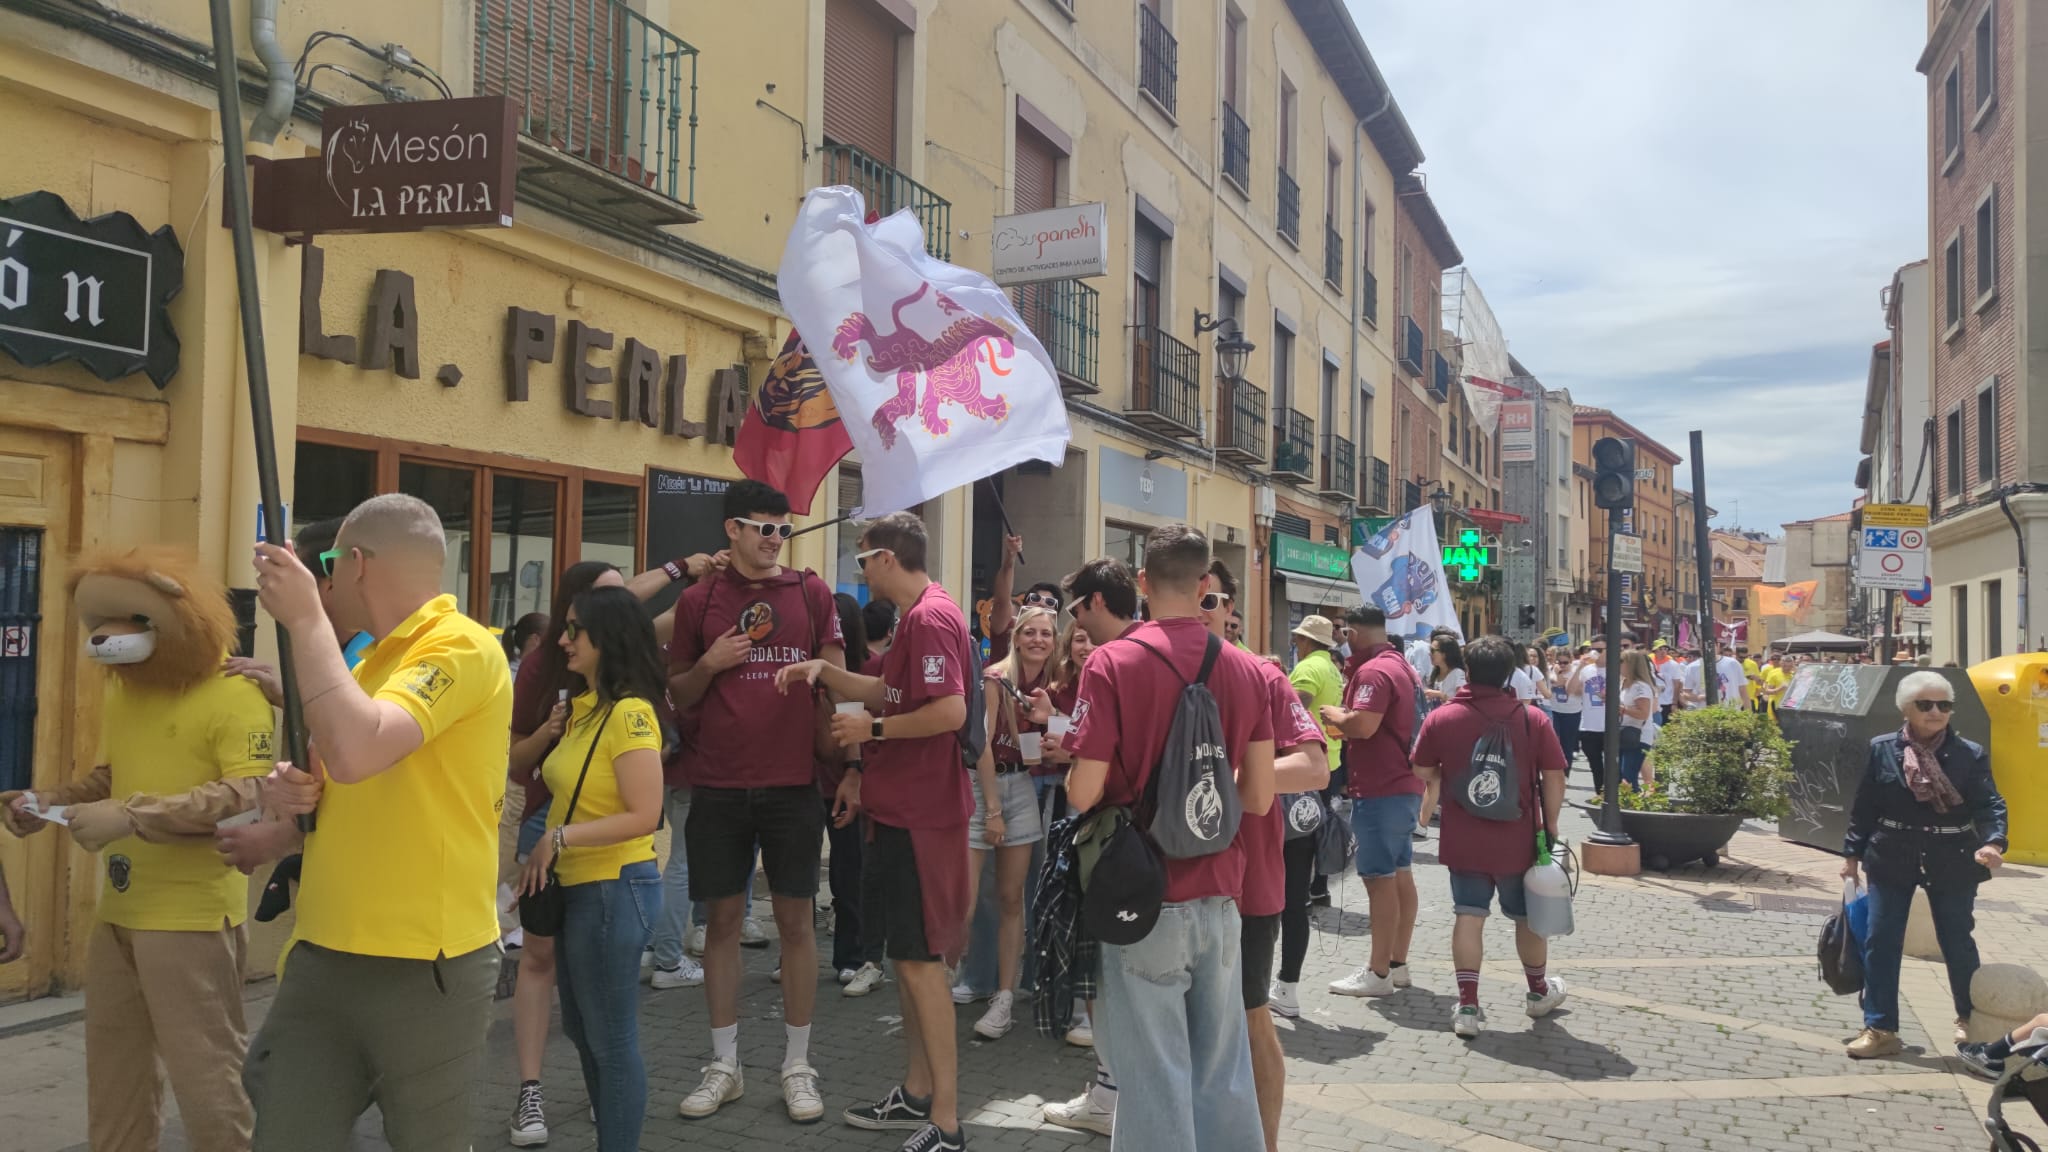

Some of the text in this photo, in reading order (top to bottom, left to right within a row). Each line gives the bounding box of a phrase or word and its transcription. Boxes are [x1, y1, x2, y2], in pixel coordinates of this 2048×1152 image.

[371, 123, 487, 165] Mesón
[352, 182, 493, 217] LA PERLA
[507, 306, 742, 448] PERLA
[1505, 412, 1527, 425] RH
